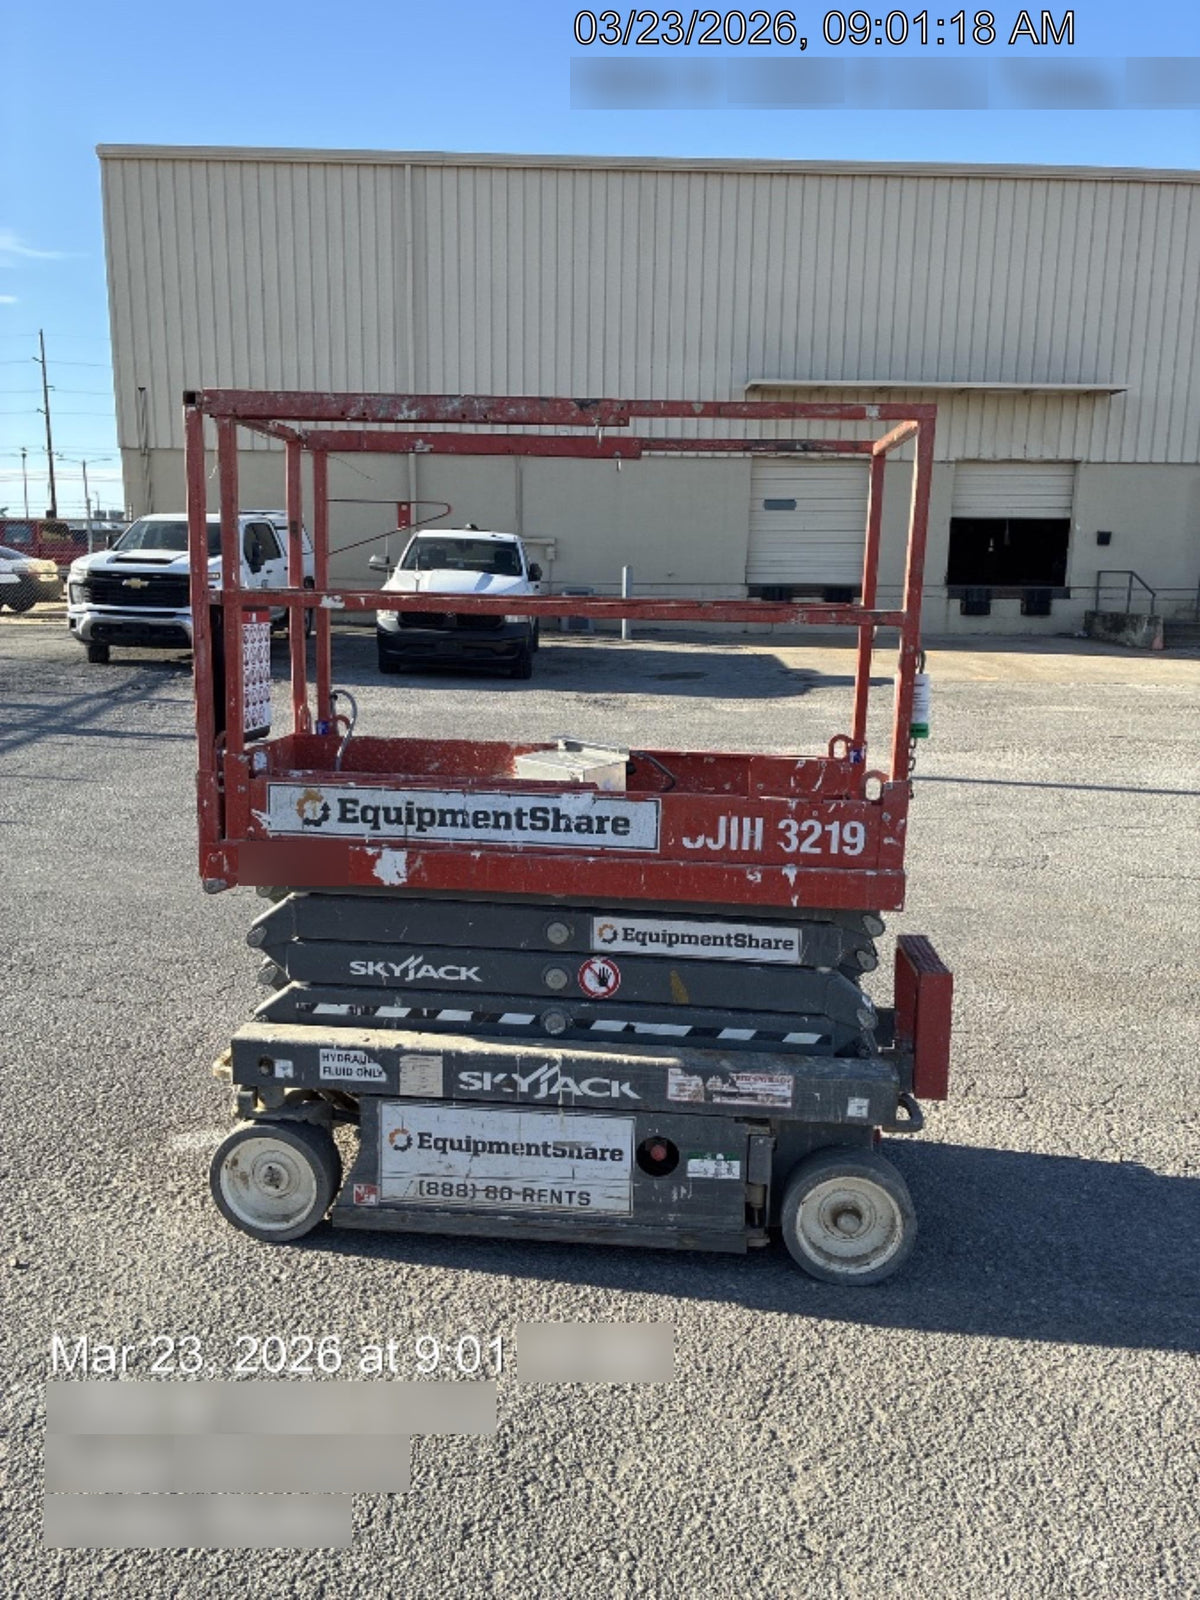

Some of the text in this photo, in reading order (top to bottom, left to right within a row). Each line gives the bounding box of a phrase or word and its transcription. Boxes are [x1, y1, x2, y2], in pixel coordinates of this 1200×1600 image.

[337, 797, 631, 837] EquipmentShare
[777, 818, 866, 856] 3219
[621, 927, 795, 950] EquipmentShare
[349, 954, 483, 982] SKYJACK
[458, 1063, 642, 1099] SKYJACK
